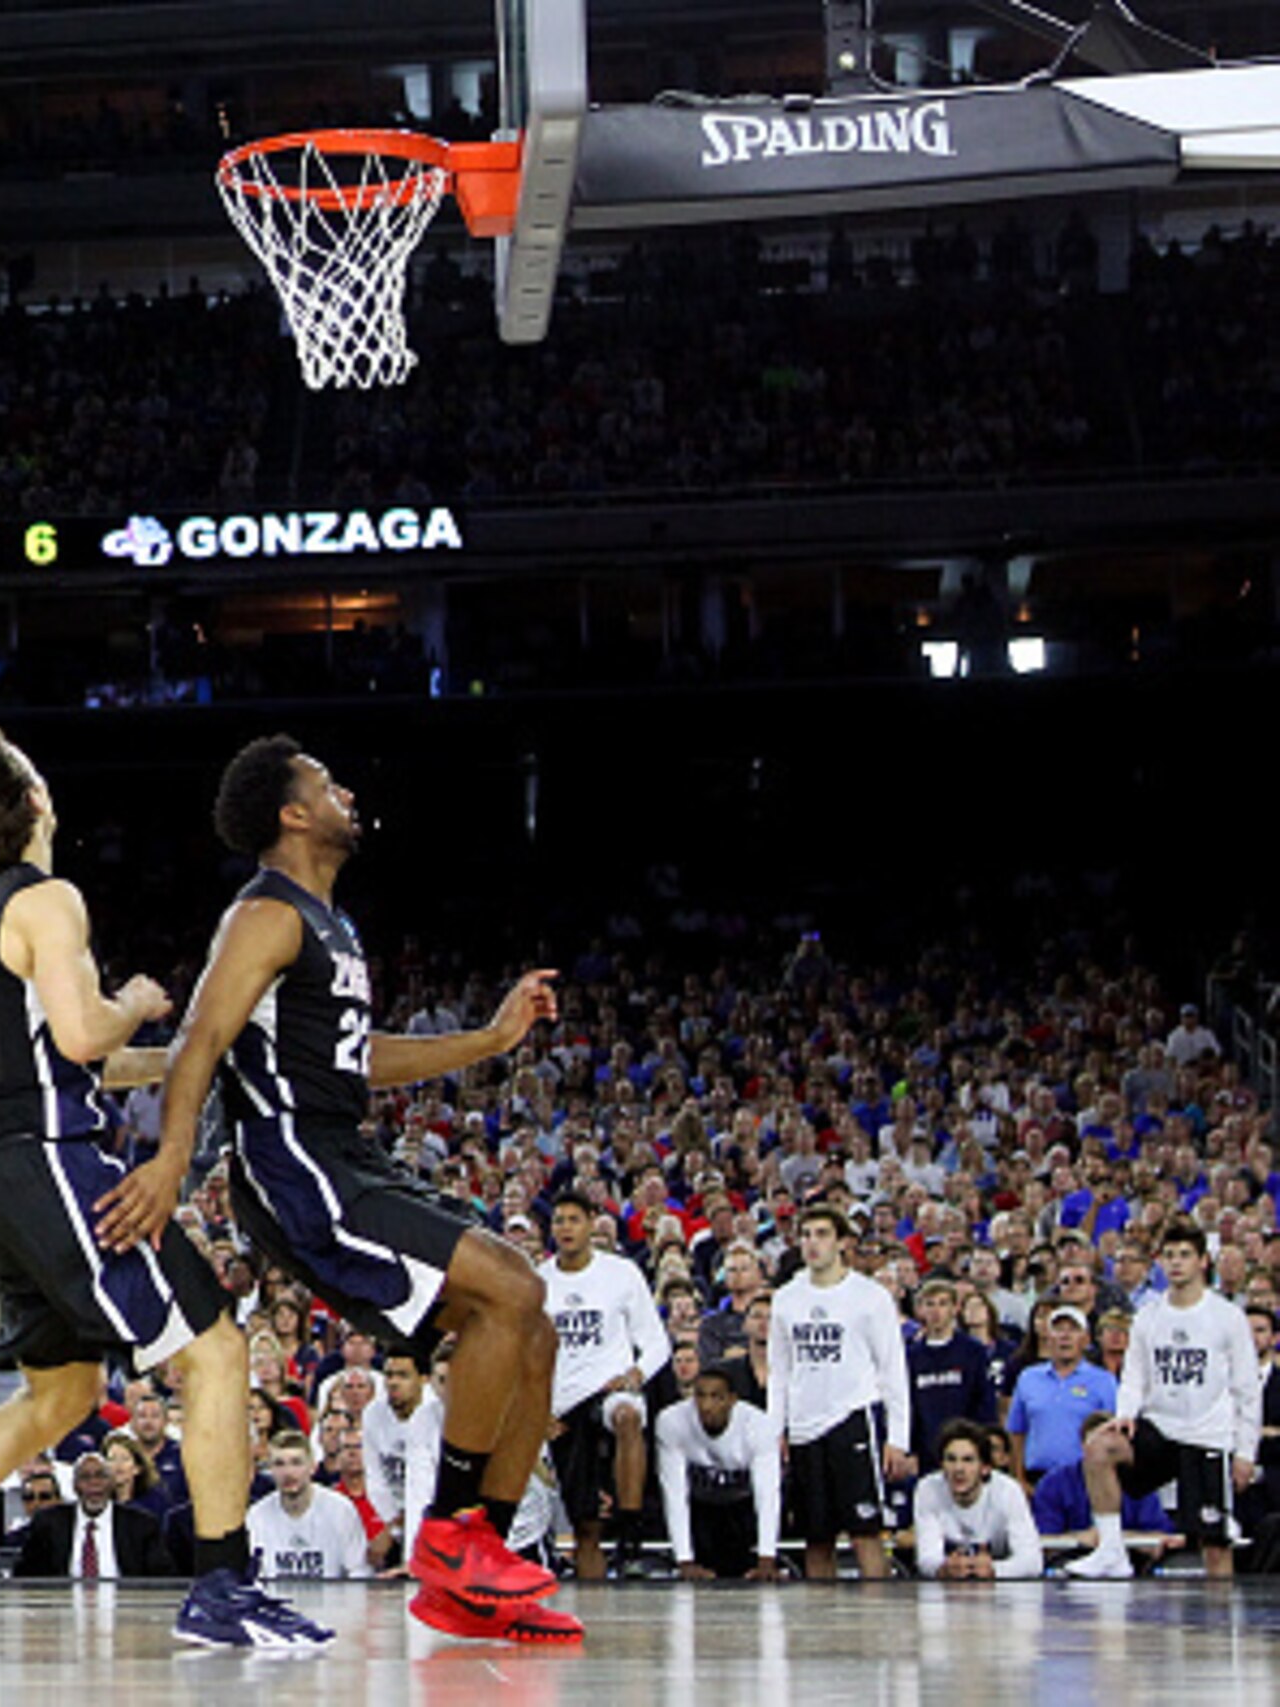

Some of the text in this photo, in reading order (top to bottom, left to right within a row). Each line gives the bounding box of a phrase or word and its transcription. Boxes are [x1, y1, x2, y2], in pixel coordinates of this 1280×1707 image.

[701, 100, 950, 166] SPALDING
[25, 522, 58, 565] 6
[178, 508, 463, 557] GONZAGA
